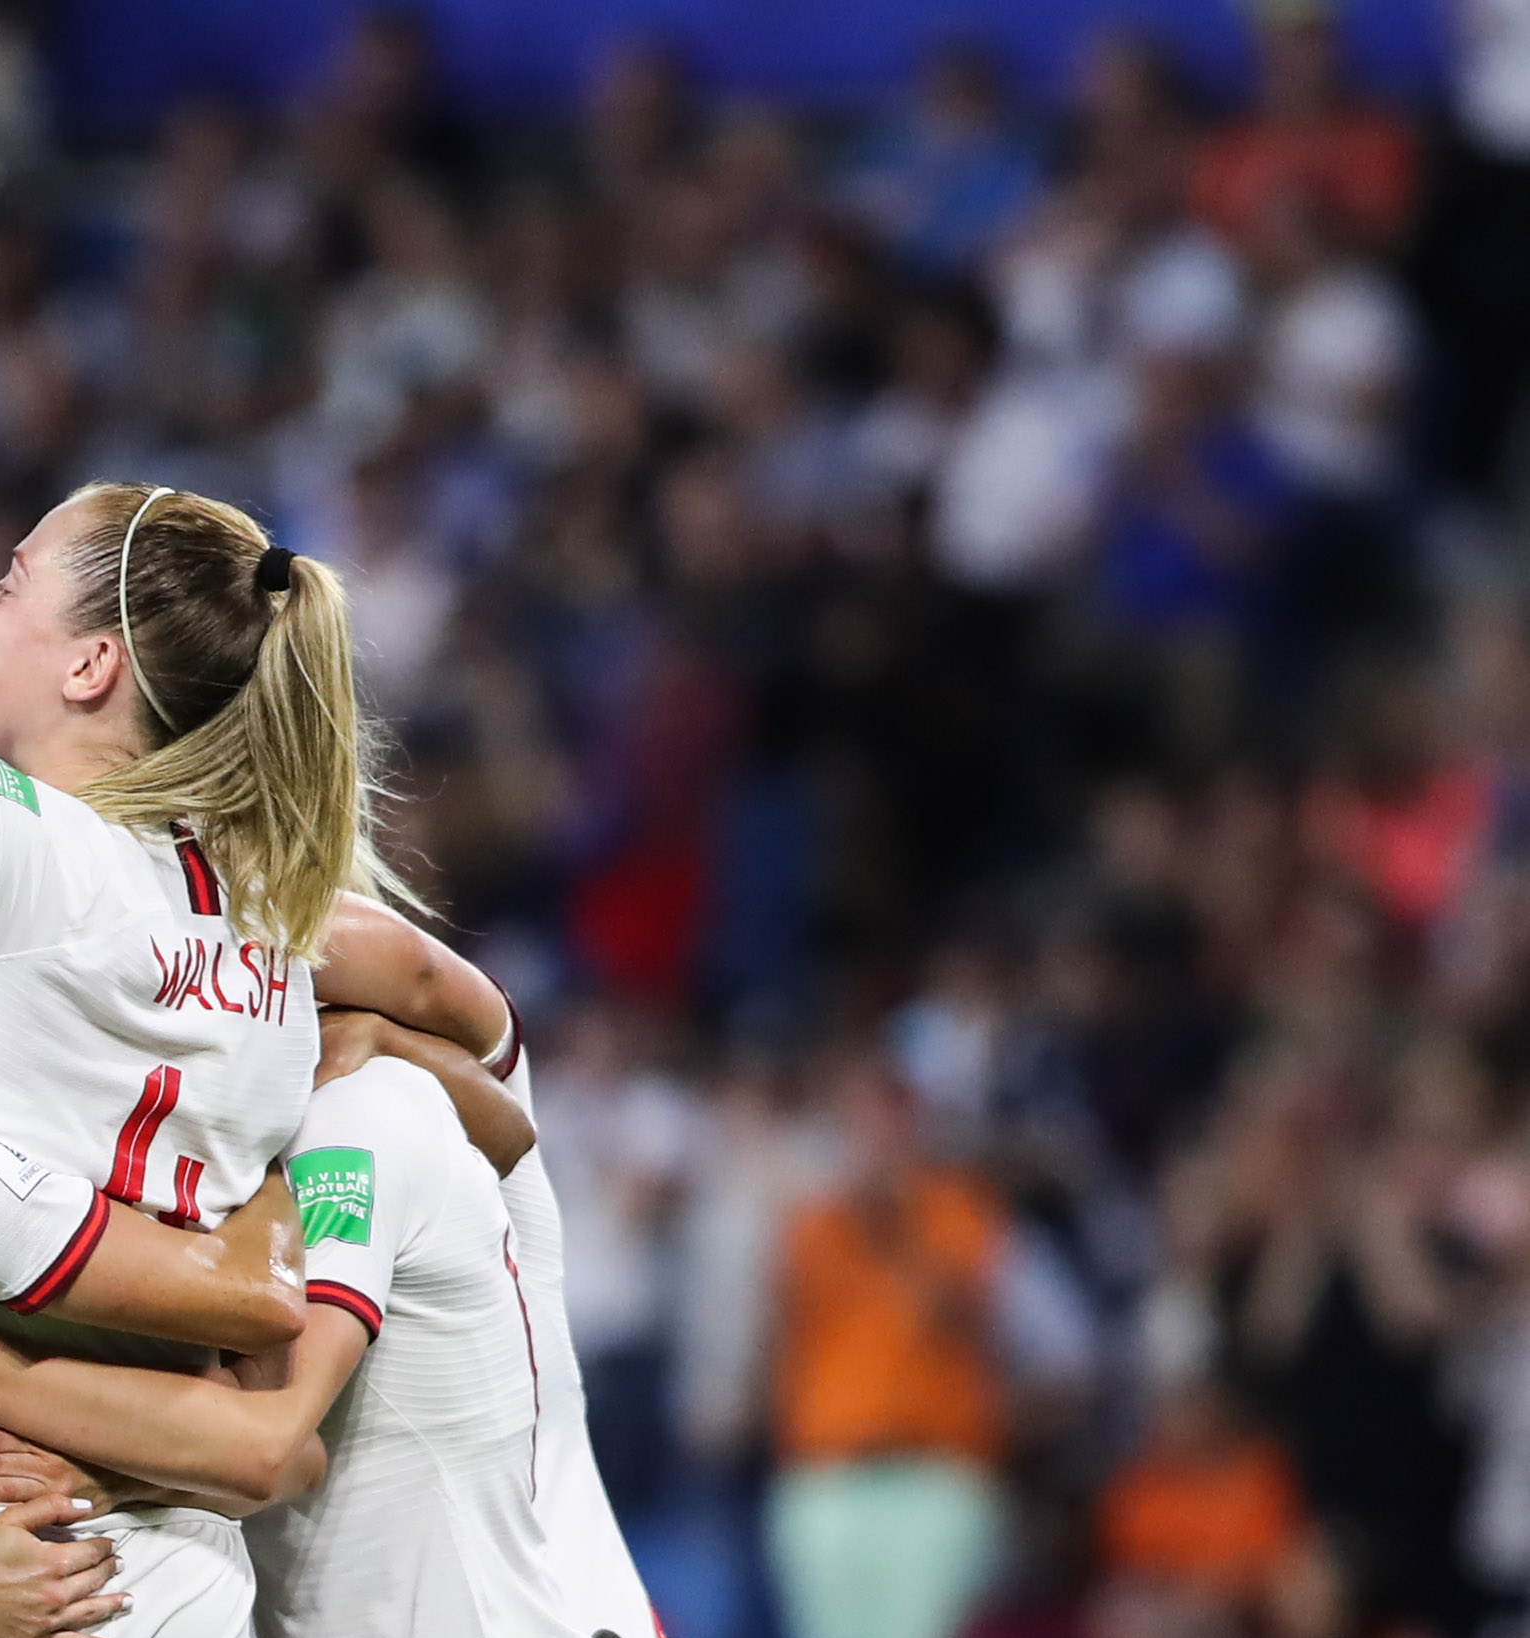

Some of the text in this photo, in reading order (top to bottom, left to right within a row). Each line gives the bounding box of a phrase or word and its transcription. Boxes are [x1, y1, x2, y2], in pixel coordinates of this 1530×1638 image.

[149, 933, 289, 1027] WALSH
[99, 1063, 205, 1230] 4
[296, 1171, 369, 1190] LIVING
[297, 1182, 370, 1200] FOOTBALL
[340, 1201, 365, 1220] FIFA
